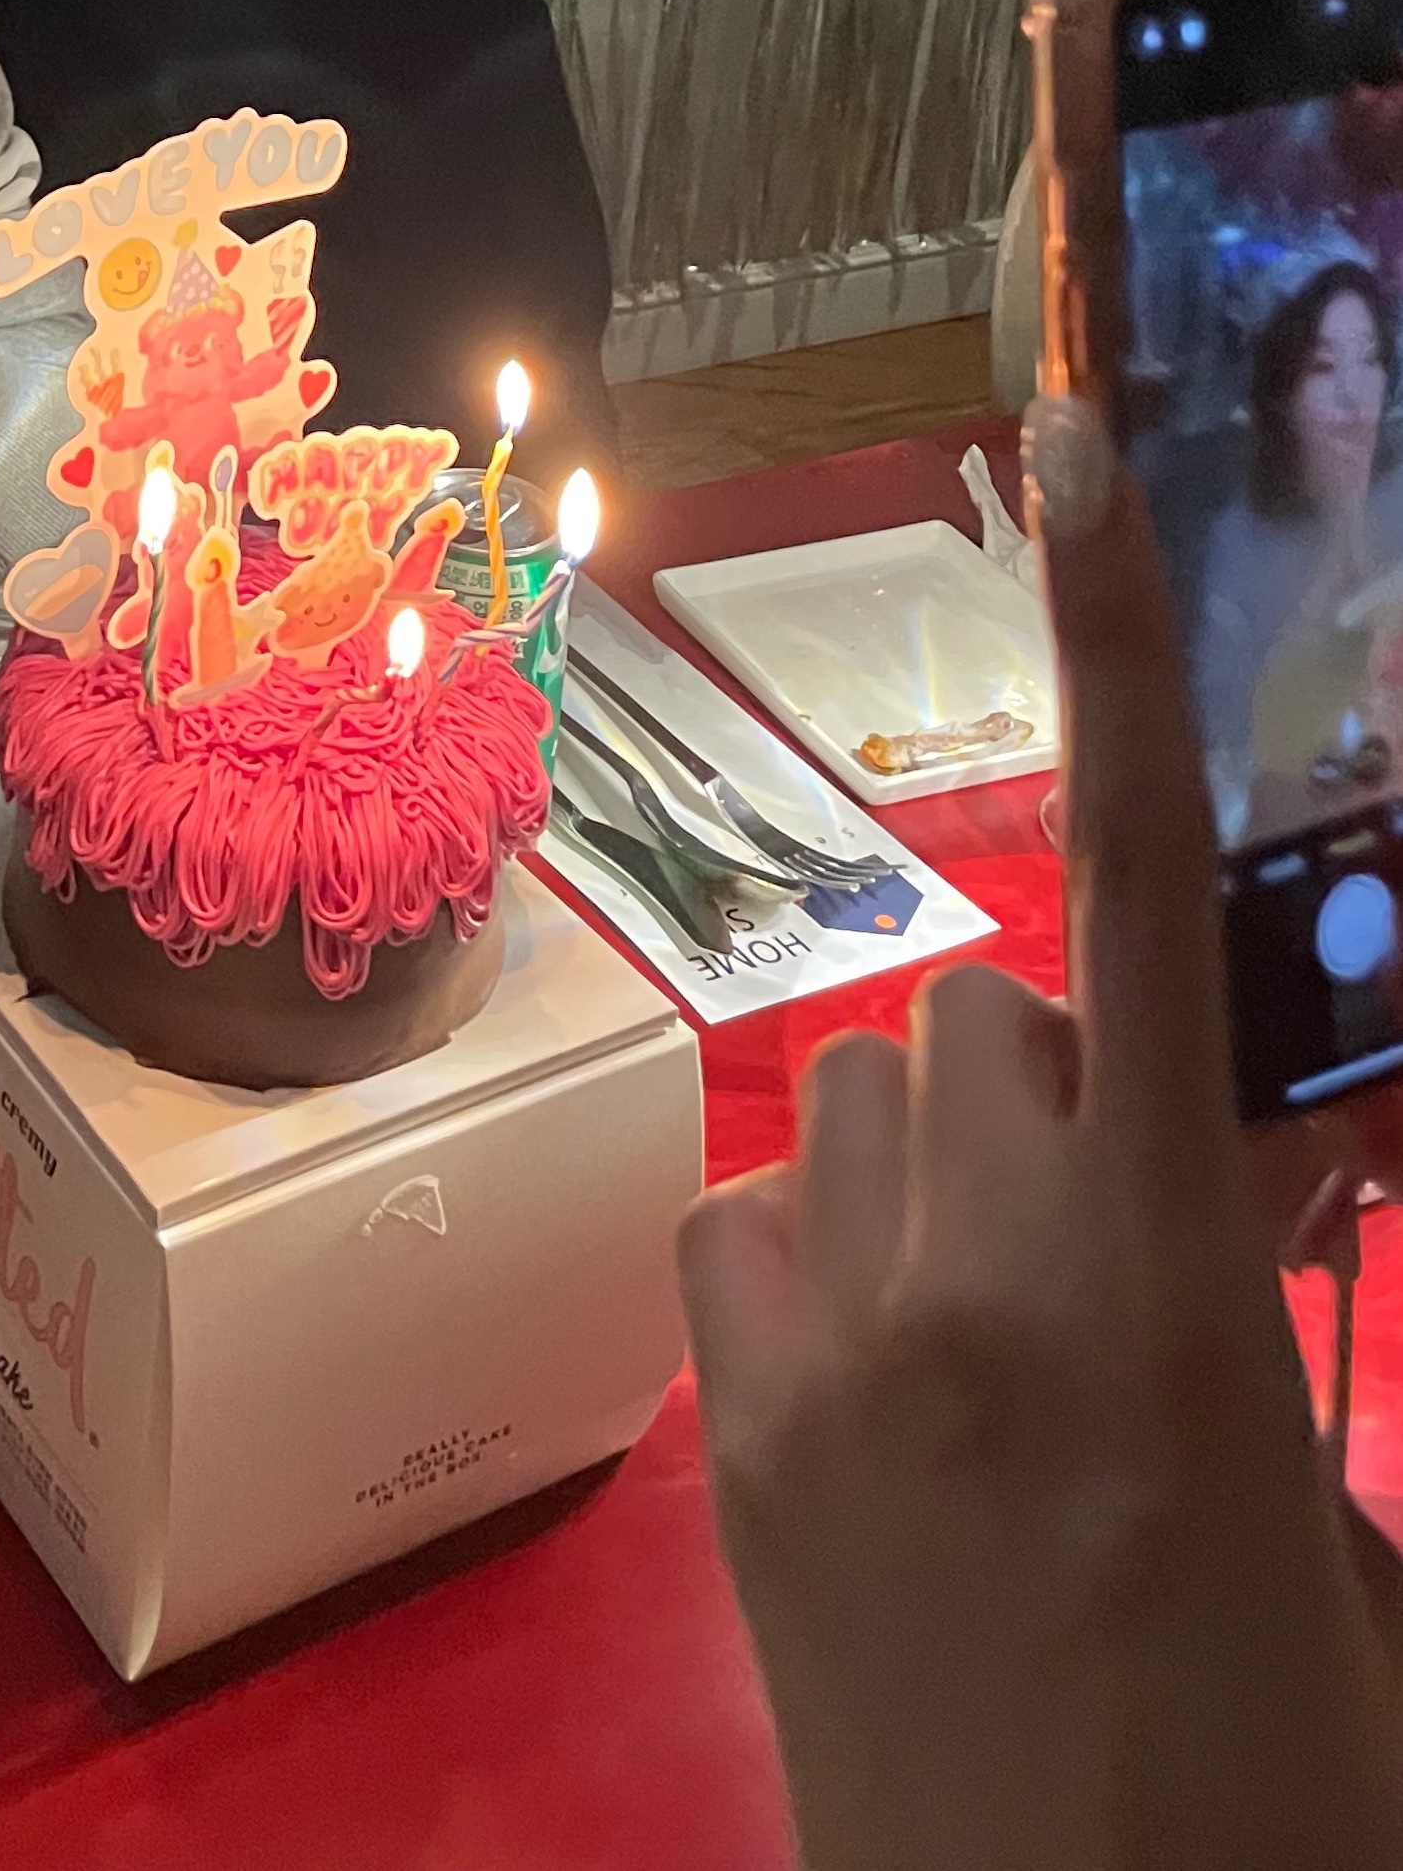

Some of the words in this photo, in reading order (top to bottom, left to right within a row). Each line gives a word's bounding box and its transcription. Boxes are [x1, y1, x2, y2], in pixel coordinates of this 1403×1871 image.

[202, 119, 342, 192] YOU
[260, 437, 450, 512] HAPPY
[687, 931, 812, 982] HOME
[402, 1427, 471, 1467] REALLY
[402, 1470, 437, 1496] THE
